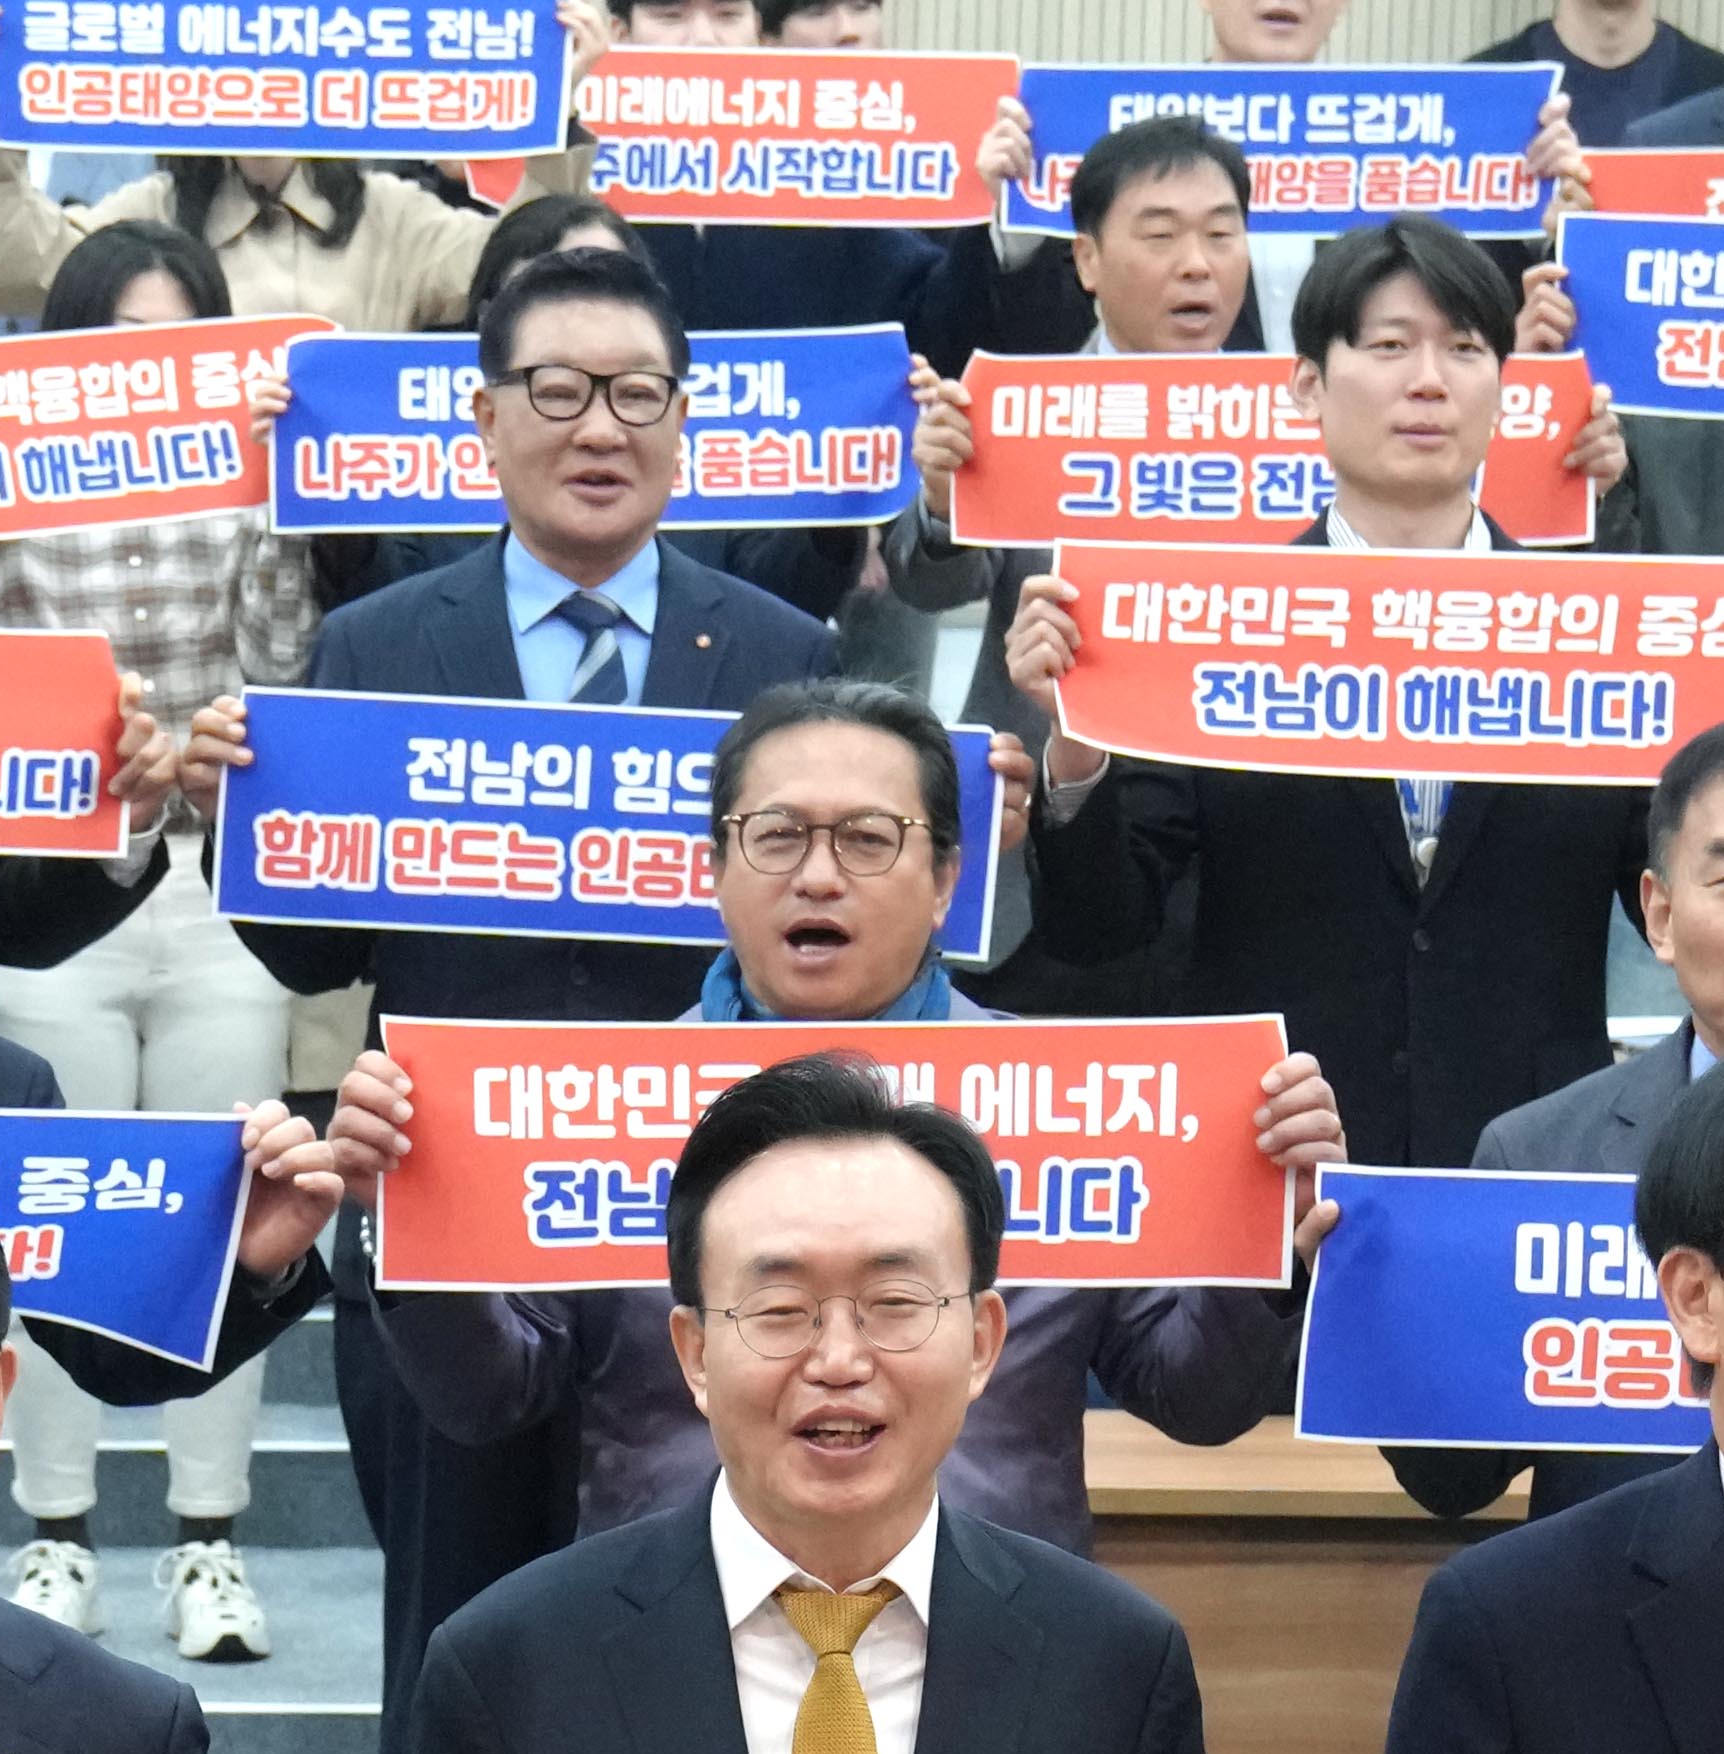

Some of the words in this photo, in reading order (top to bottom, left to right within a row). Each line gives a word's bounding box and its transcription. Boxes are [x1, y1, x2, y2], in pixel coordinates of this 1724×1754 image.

[23, 0, 164, 55] 글로벌
[178, 6, 410, 58] 에너지수도
[427, 9, 534, 58] 전남!
[24, 70, 303, 122] 인공태양으로
[318, 70, 361, 122] 더
[377, 72, 533, 126] 뜨겁게!
[579, 76, 800, 126] 미래에너지
[813, 78, 918, 132] 중심,
[1304, 94, 1456, 147] 뜨겁게,
[591, 142, 713, 192] 주에서
[729, 144, 958, 196] 시작합니다
[687, 361, 801, 421] 겁게,
[992, 385, 1150, 440] 미래를
[23, 426, 236, 491] 해냅니다!
[297, 439, 442, 495] 나주가
[700, 429, 898, 491] 품습니다!
[1061, 458, 1116, 512] 그
[1136, 458, 1239, 515] 빛은
[1102, 582, 1349, 649] 대한민국
[1372, 589, 1619, 656] 핵융합의
[1198, 669, 1381, 735] 전남이
[1402, 673, 1669, 742] 해냅니다!
[405, 736, 591, 812] 전남의
[259, 815, 370, 888] 함께
[391, 824, 557, 893] 만드는
[960, 1060, 1199, 1143] 에너지,
[18, 1155, 185, 1217] 중심,
